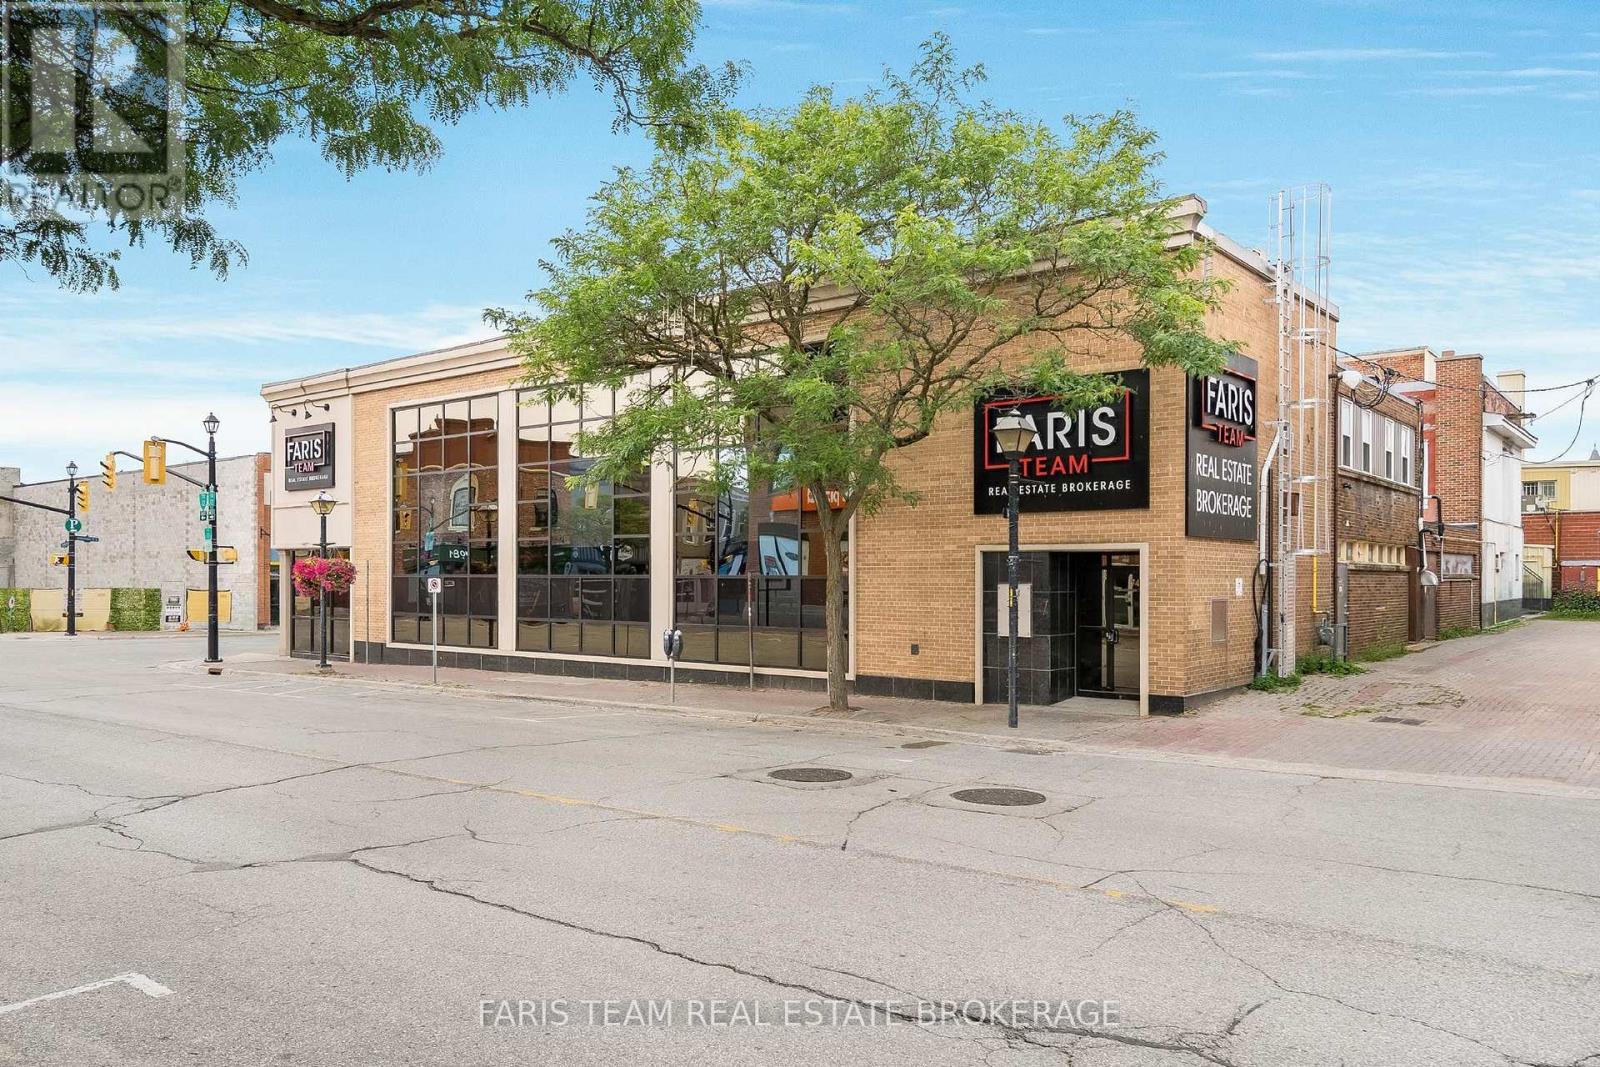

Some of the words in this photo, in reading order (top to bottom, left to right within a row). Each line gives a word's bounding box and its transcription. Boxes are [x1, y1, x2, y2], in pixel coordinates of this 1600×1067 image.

[1207, 377, 1253, 426] FARIS
[1216, 423, 1245, 448] TEAM
[287, 438, 321, 461] FARIS
[294, 462, 314, 473] TEAM
[1020, 454, 1088, 477] TEAM
[1196, 452, 1219, 480] REAL
[1222, 459, 1252, 486] ESTATE
[988, 486, 1010, 497] REA
[1019, 483, 1056, 495] ESTATE
[1062, 480, 1131, 493] BROKERAGE
[1196, 488, 1252, 518] BROKERAGE
